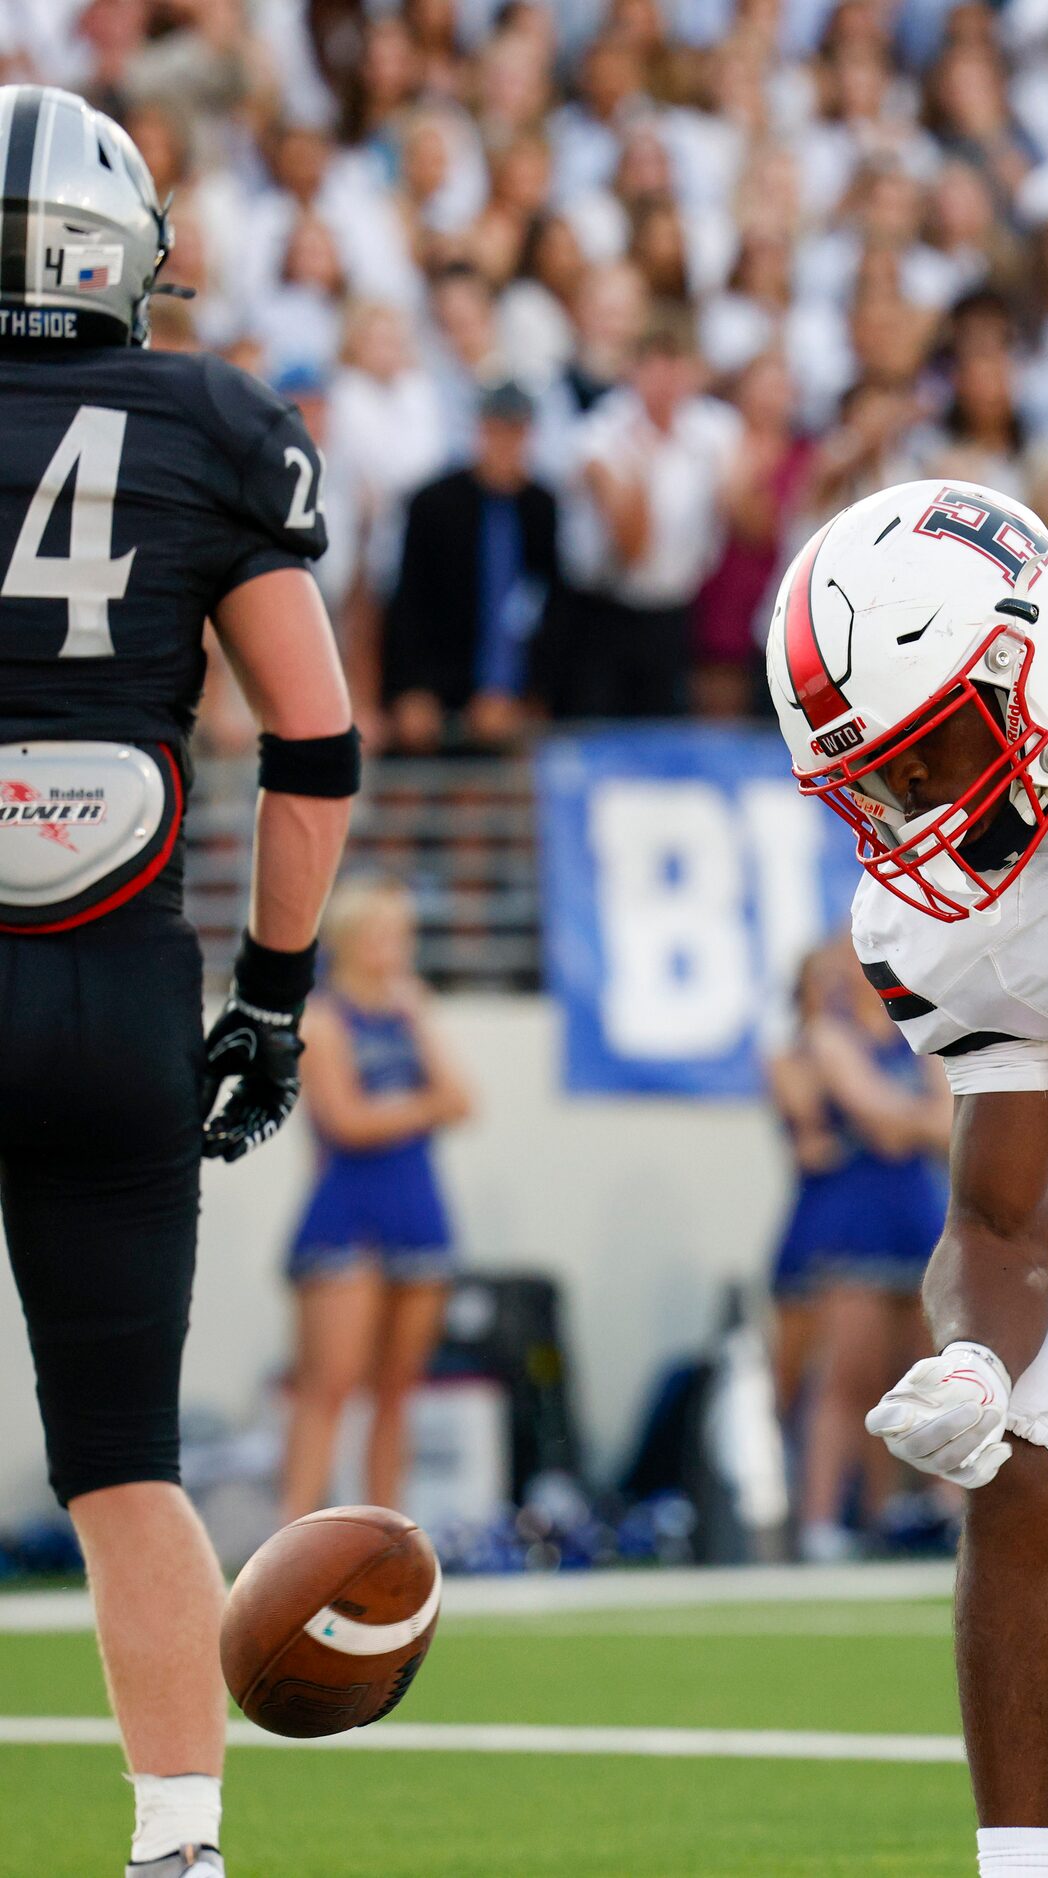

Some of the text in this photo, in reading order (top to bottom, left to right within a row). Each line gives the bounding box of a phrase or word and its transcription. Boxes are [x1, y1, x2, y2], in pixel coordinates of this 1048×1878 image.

[45, 247, 64, 286] 4
[1, 405, 138, 658] 4
[821, 726, 859, 754] WTD
[49, 787, 104, 799] Riddell
